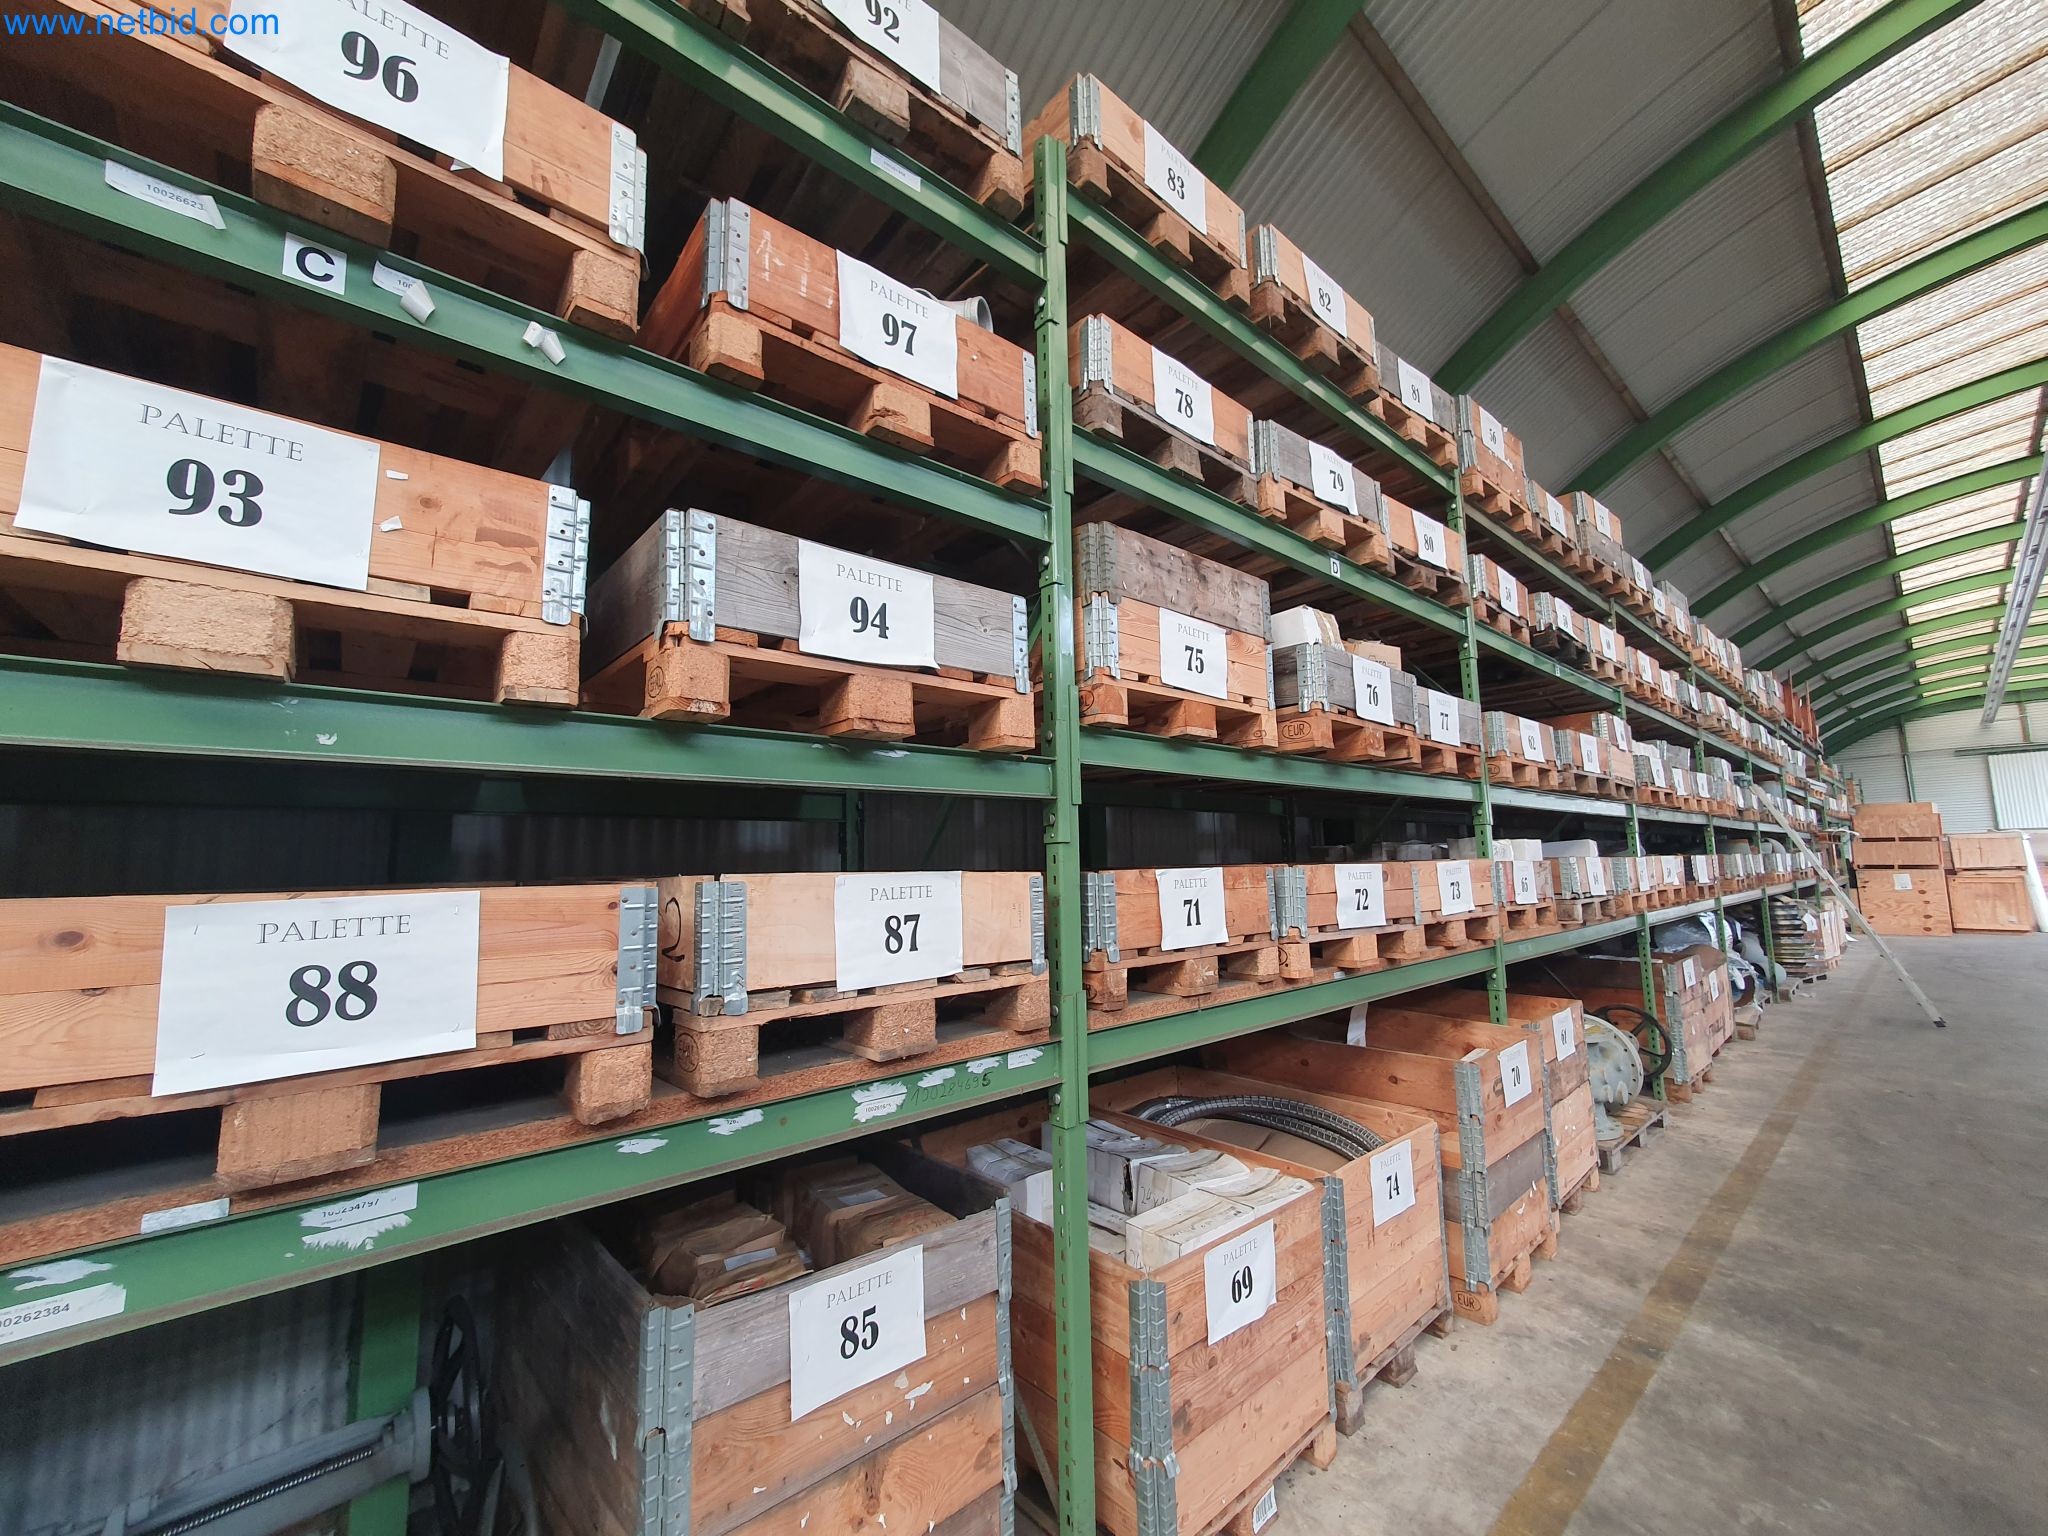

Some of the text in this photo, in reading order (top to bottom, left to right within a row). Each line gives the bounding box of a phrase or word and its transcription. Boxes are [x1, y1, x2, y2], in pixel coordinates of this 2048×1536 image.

[338, 0, 449, 60] LETTE
[866, 0, 900, 44] 92
[341, 31, 419, 103] 96
[1168, 168, 1185, 200] 83
[296, 246, 335, 282] C
[869, 279, 929, 319] PALETTE
[1318, 287, 1332, 313] 82
[882, 312, 918, 357] 97
[1175, 388, 1194, 419] 78
[1411, 385, 1421, 404] 81
[139, 402, 304, 462] PALETTE
[166, 458, 264, 528] 93
[1330, 469, 1344, 493] 79
[1424, 534, 1434, 553] 80
[836, 562, 903, 593] PALETTE
[1332, 562, 1339, 574] D
[850, 596, 889, 640] 94
[1178, 623, 1210, 642] PALETTE
[1184, 645, 1205, 674] 75
[1367, 683, 1379, 707] 76
[1287, 723, 1305, 737] EUR
[1440, 712, 1449, 731] 77
[870, 885, 933, 901] PALETTE
[1174, 878, 1208, 890] PALETTE
[1450, 881, 1461, 900] 73
[1183, 898, 1202, 927] 71
[1355, 888, 1369, 911] 72
[256, 914, 412, 944] PALETTE
[662, 897, 685, 962] 2
[884, 914, 921, 954] 87
[285, 960, 379, 1028] 88
[1511, 1065, 1521, 1087] 70
[1386, 1171, 1400, 1200] 74
[1223, 1238, 1258, 1266] PALETTE
[827, 1271, 893, 1309] PALETTE
[1231, 1265, 1254, 1304] 69
[0, 1303, 70, 1328] 0262384
[1457, 1293, 1476, 1310] EUR
[840, 1305, 879, 1360] 85
